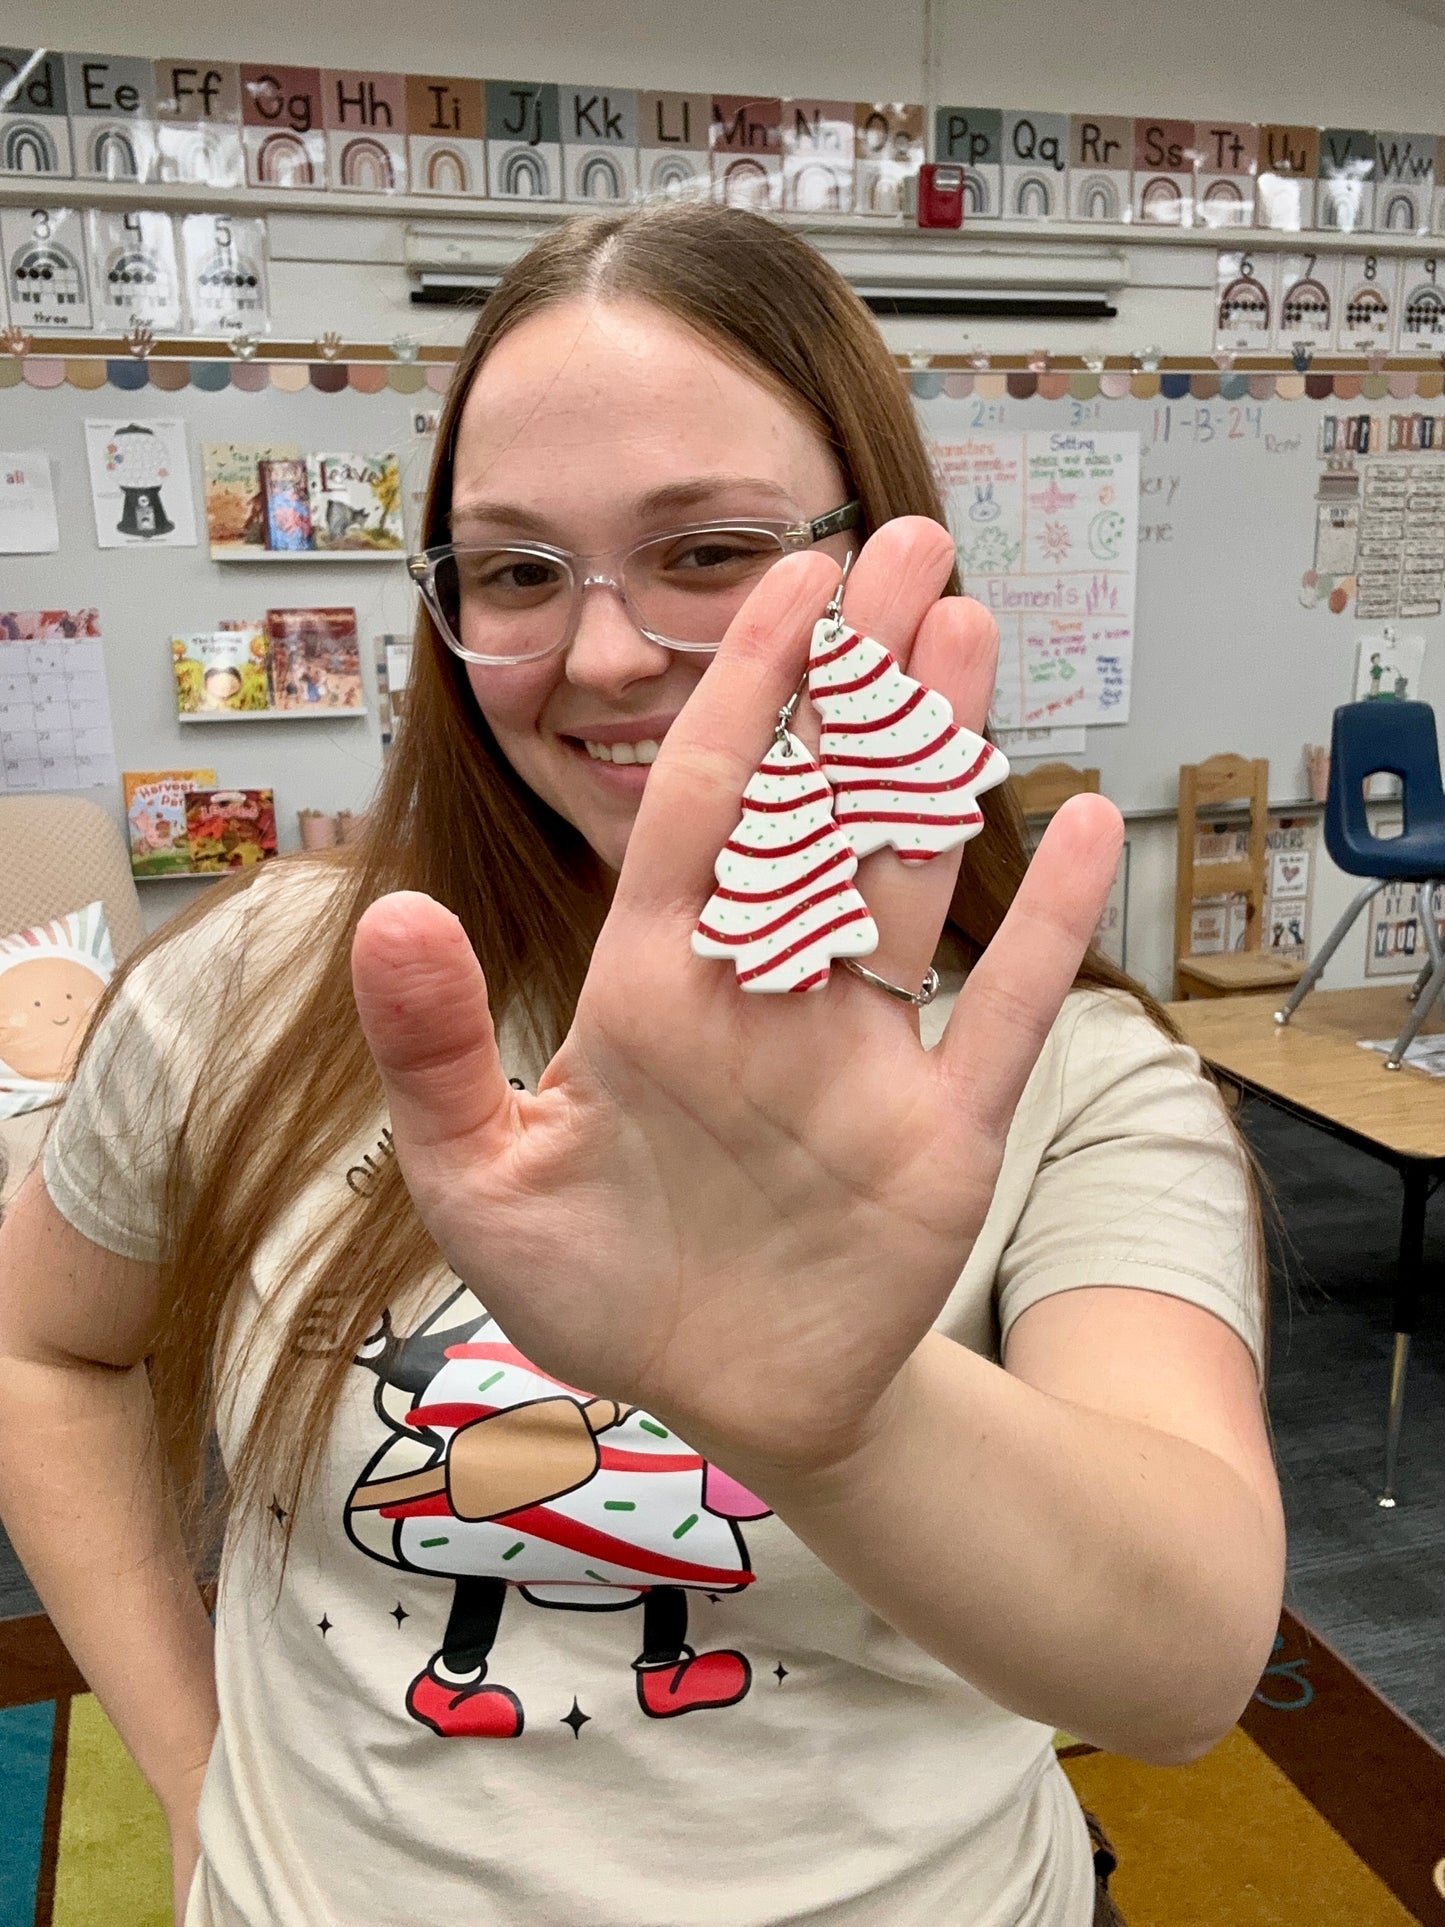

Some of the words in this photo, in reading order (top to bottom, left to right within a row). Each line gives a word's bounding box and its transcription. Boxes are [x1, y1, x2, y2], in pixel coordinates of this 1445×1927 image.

[81, 64, 139, 111] Ee
[172, 68, 222, 115] Ff
[254, 75, 312, 132] Gg
[337, 80, 392, 127] Hh
[428, 86, 461, 131] Ii
[504, 91, 543, 145] Jj
[575, 96, 625, 139] Kk
[658, 102, 690, 142] Ll
[948, 116, 990, 165] Pp
[1013, 120, 1064, 171] Qq
[1082, 124, 1120, 163] Rr
[1146, 128, 1183, 167] Ss
[1210, 130, 1245, 169] Tt
[1267, 133, 1307, 173] Uu
[1378, 142, 1432, 179] Ww
[31, 208, 50, 240] 3
[123, 212, 143, 243] 4
[214, 216, 232, 247] 5
[1240, 253, 1254, 278] 6
[1304, 252, 1317, 279] 7
[1364, 256, 1377, 280] 8
[1424, 258, 1437, 285] 9
[34, 312, 68, 325] three
[129, 313, 154, 328] four
[219, 320, 243, 331] five
[1050, 433, 1095, 455] Setting
[987, 579, 1080, 610] Elements
[138, 783, 195, 799] Harvest
[160, 794, 186, 807] Par
